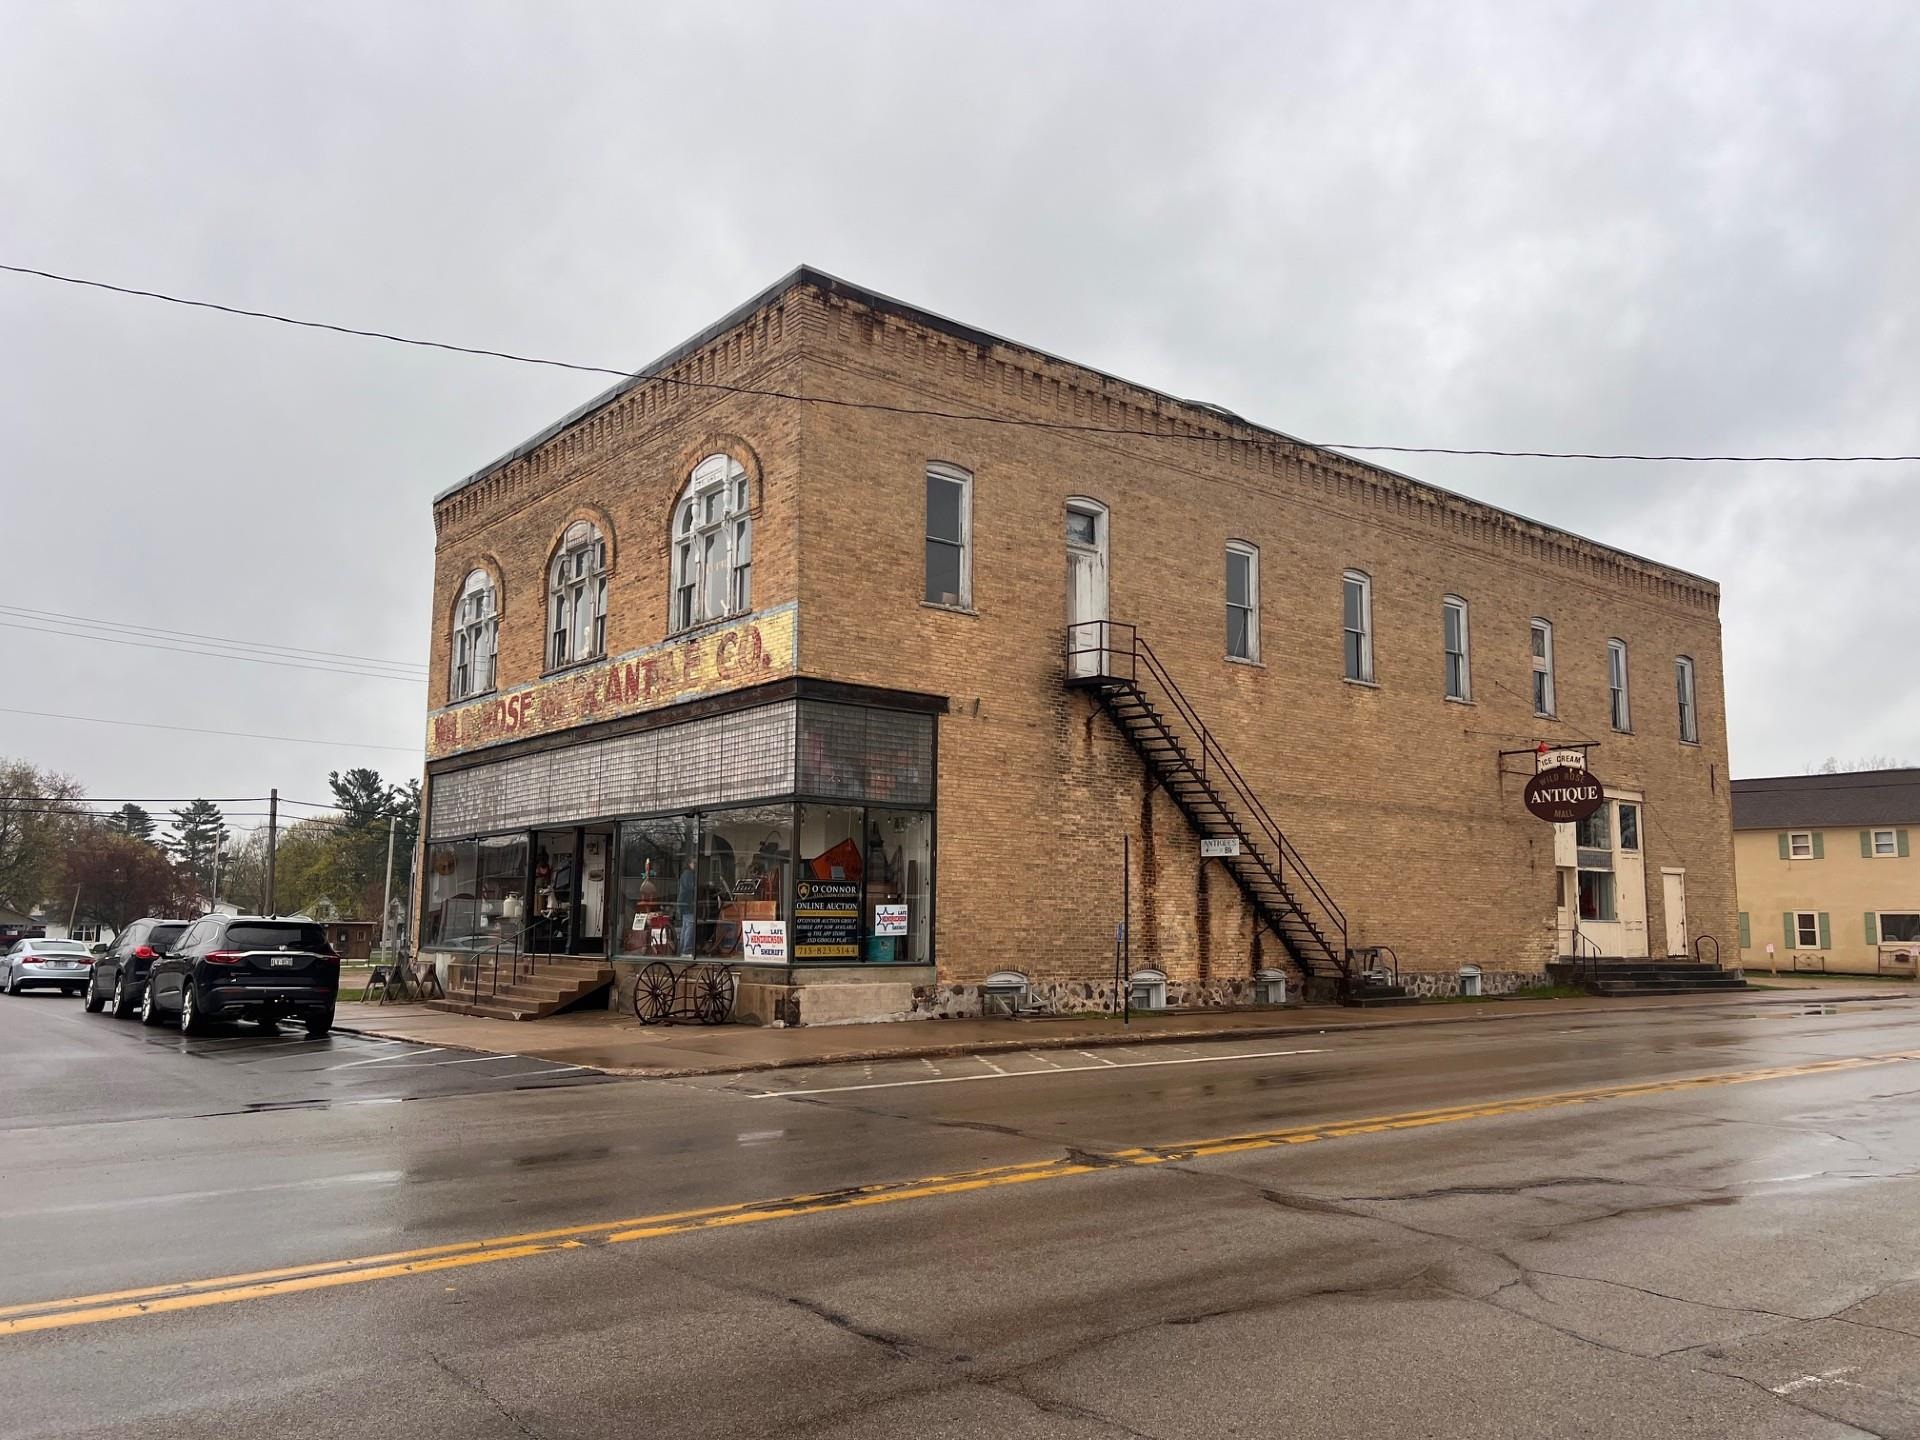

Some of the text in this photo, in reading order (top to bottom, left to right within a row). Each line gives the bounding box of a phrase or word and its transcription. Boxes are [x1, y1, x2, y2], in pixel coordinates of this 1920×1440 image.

[434, 707, 478, 750] WIL
[1541, 755, 1581, 766] ICE CREAM
[1540, 773, 1584, 785] WILD ROSE
[1530, 786, 1598, 803] ANTIQUE
[1553, 809, 1574, 818] MALL
[1203, 840, 1236, 848] ANTIQUES
[811, 885, 856, 894] O'CONNOR
[796, 902, 857, 910] ONLINE AUCTION
[751, 935, 784, 944] HENDRICKSON
[760, 948, 784, 956] SHERIFF
[798, 946, 855, 955] 715-823-5144
